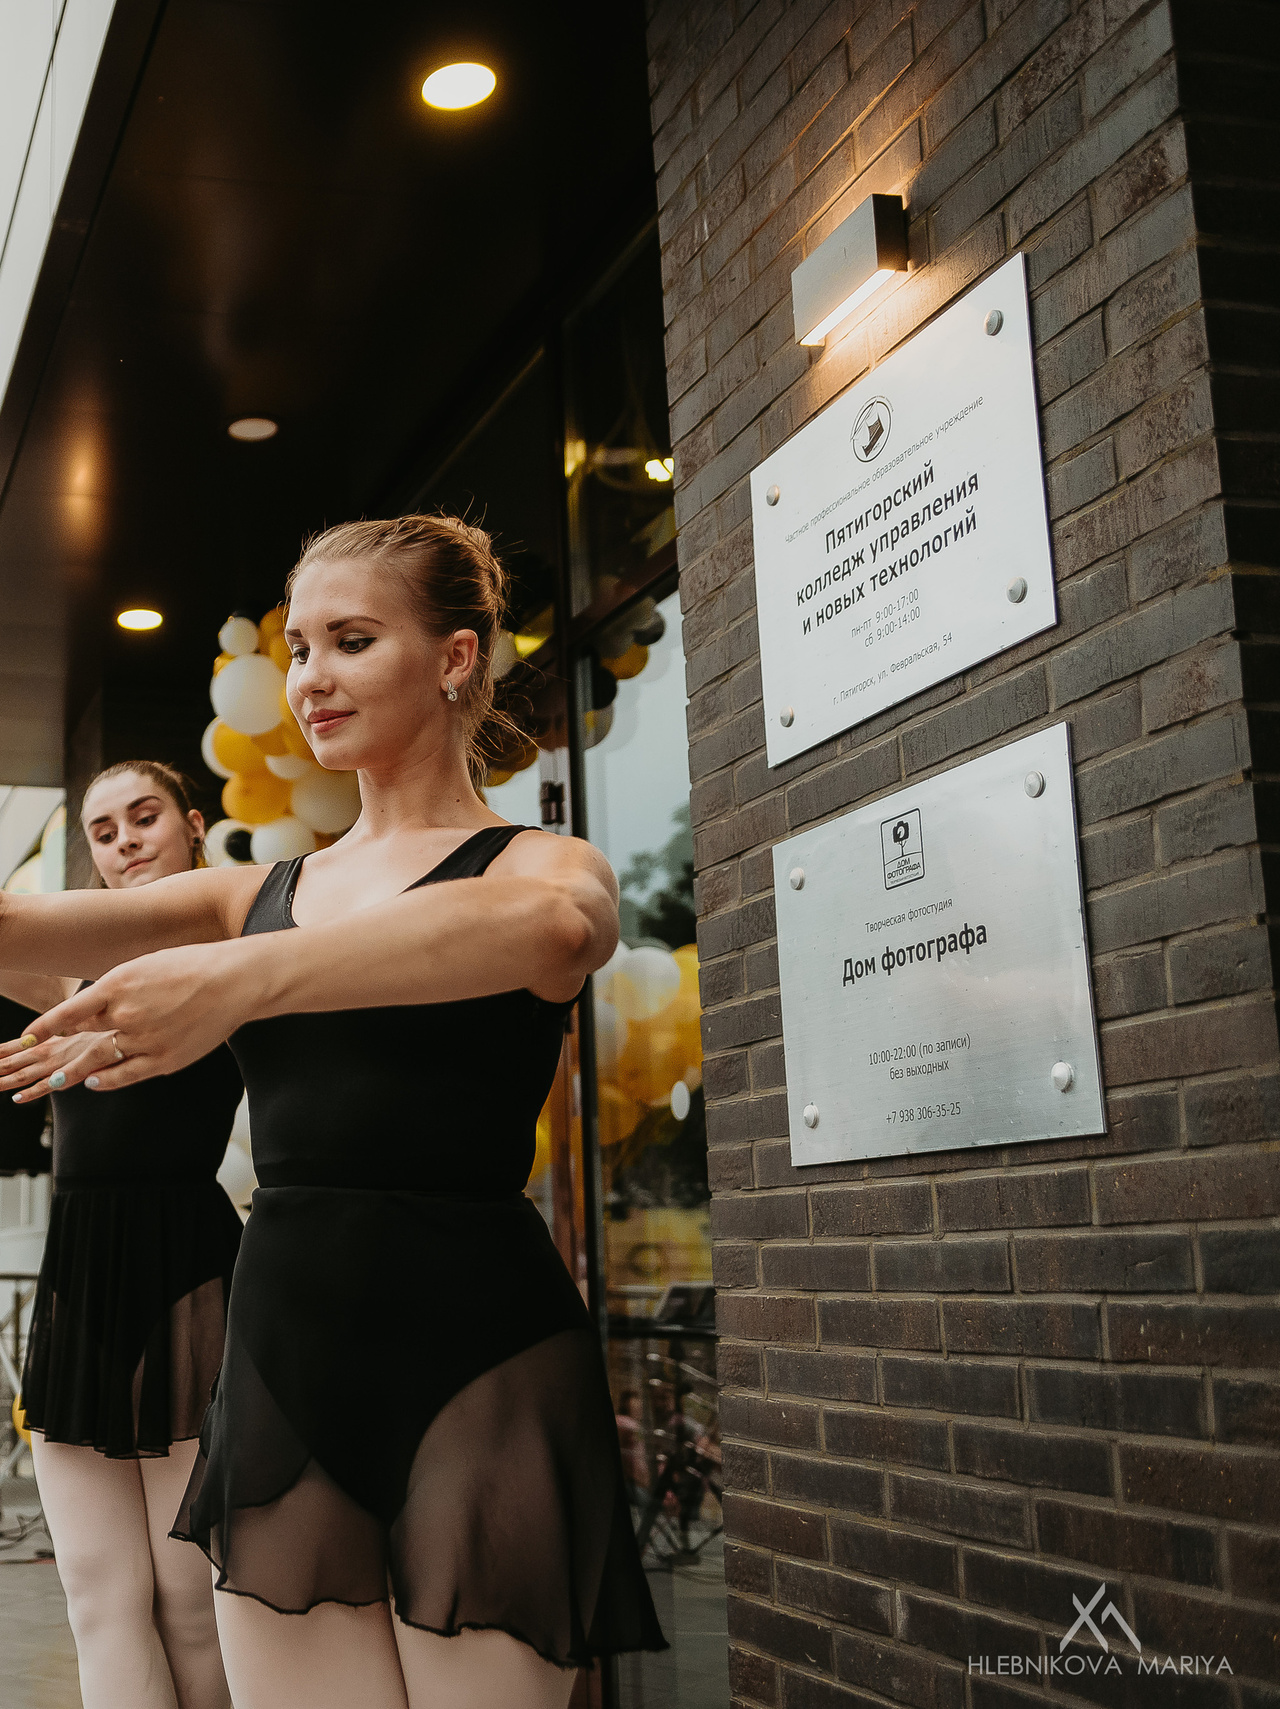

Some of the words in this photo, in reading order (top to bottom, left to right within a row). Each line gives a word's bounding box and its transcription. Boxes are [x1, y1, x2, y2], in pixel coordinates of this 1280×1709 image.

[811, 477, 871, 527] профессиональное
[872, 432, 933, 482] образовательное
[936, 396, 984, 439] учреждение
[825, 459, 935, 554] Пятигорский
[796, 548, 865, 606] колледж
[870, 473, 979, 563] управления
[803, 617, 811, 635] и
[816, 582, 865, 627] новых
[870, 506, 977, 591] технологий
[851, 618, 872, 638] пн-пт
[876, 588, 919, 623] 9:00-17:00
[864, 633, 874, 648] сб
[876, 606, 920, 641] 9:00-14:00
[840, 677, 876, 702] Пятигорск,
[877, 671, 888, 683] ул.
[890, 642, 941, 673] Февральская,
[942, 632, 953, 646] 54
[887, 862, 921, 879] ФОТОГРАФА
[896, 858, 910, 868] ДОМ
[865, 912, 906, 933] Творческая
[907, 898, 953, 922] фотостудия
[842, 956, 876, 987] Дом
[881, 922, 987, 976] фотографа
[869, 1044, 916, 1065] 10:00-22:00
[919, 1042, 933, 1058] (по
[936, 1033, 971, 1052] записи)
[889, 1067, 904, 1080] без
[906, 1060, 950, 1077] выходных
[886, 1111, 897, 1123] +7
[900, 1108, 914, 1122] 938
[917, 1102, 961, 1120] 306-35-25
